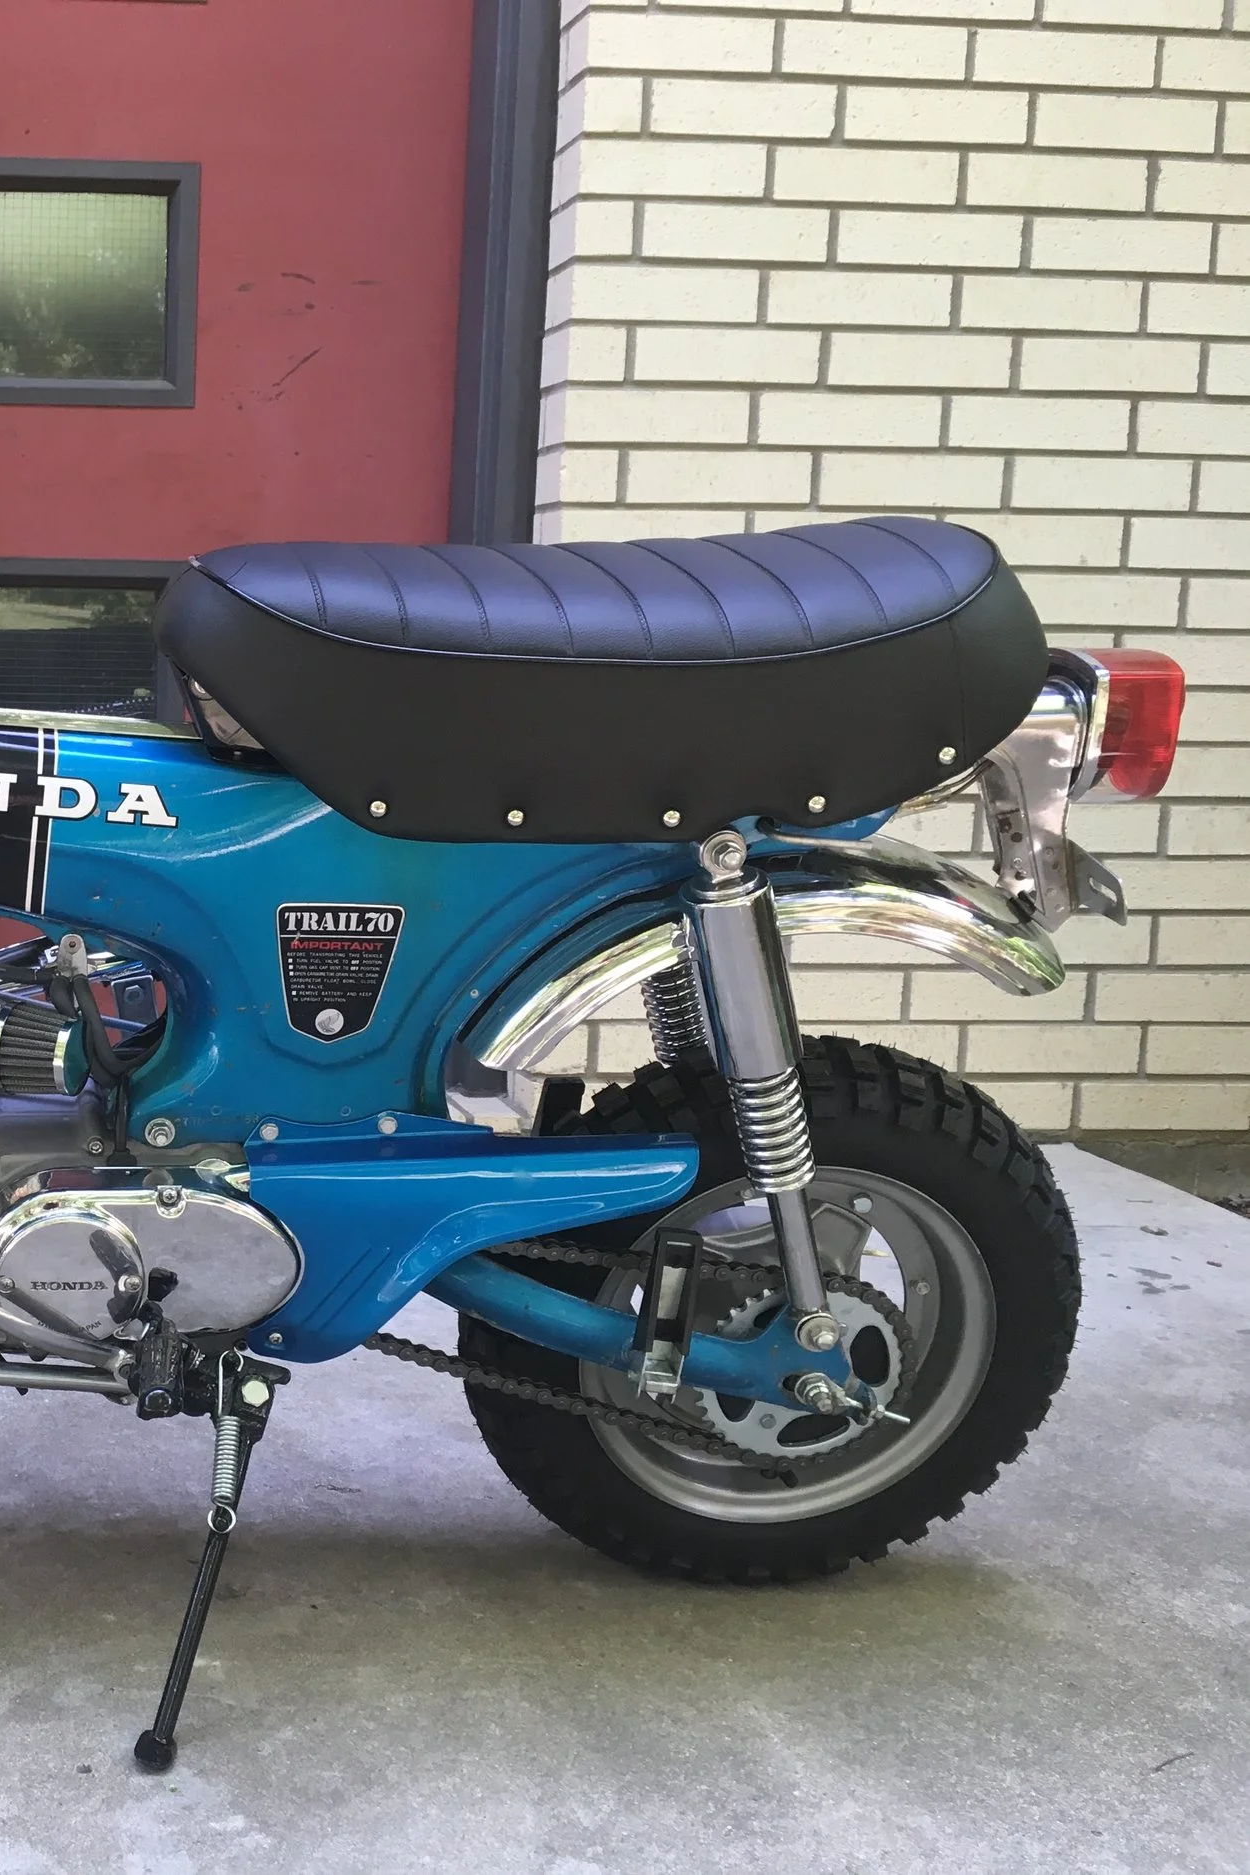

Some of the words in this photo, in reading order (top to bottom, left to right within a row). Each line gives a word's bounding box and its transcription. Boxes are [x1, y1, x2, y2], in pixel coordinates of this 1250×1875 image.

[291, 940, 383, 950] IMPORTANT
[30, 1281, 109, 1291] HONDA
[78, 1320, 102, 1333] JAPAN
